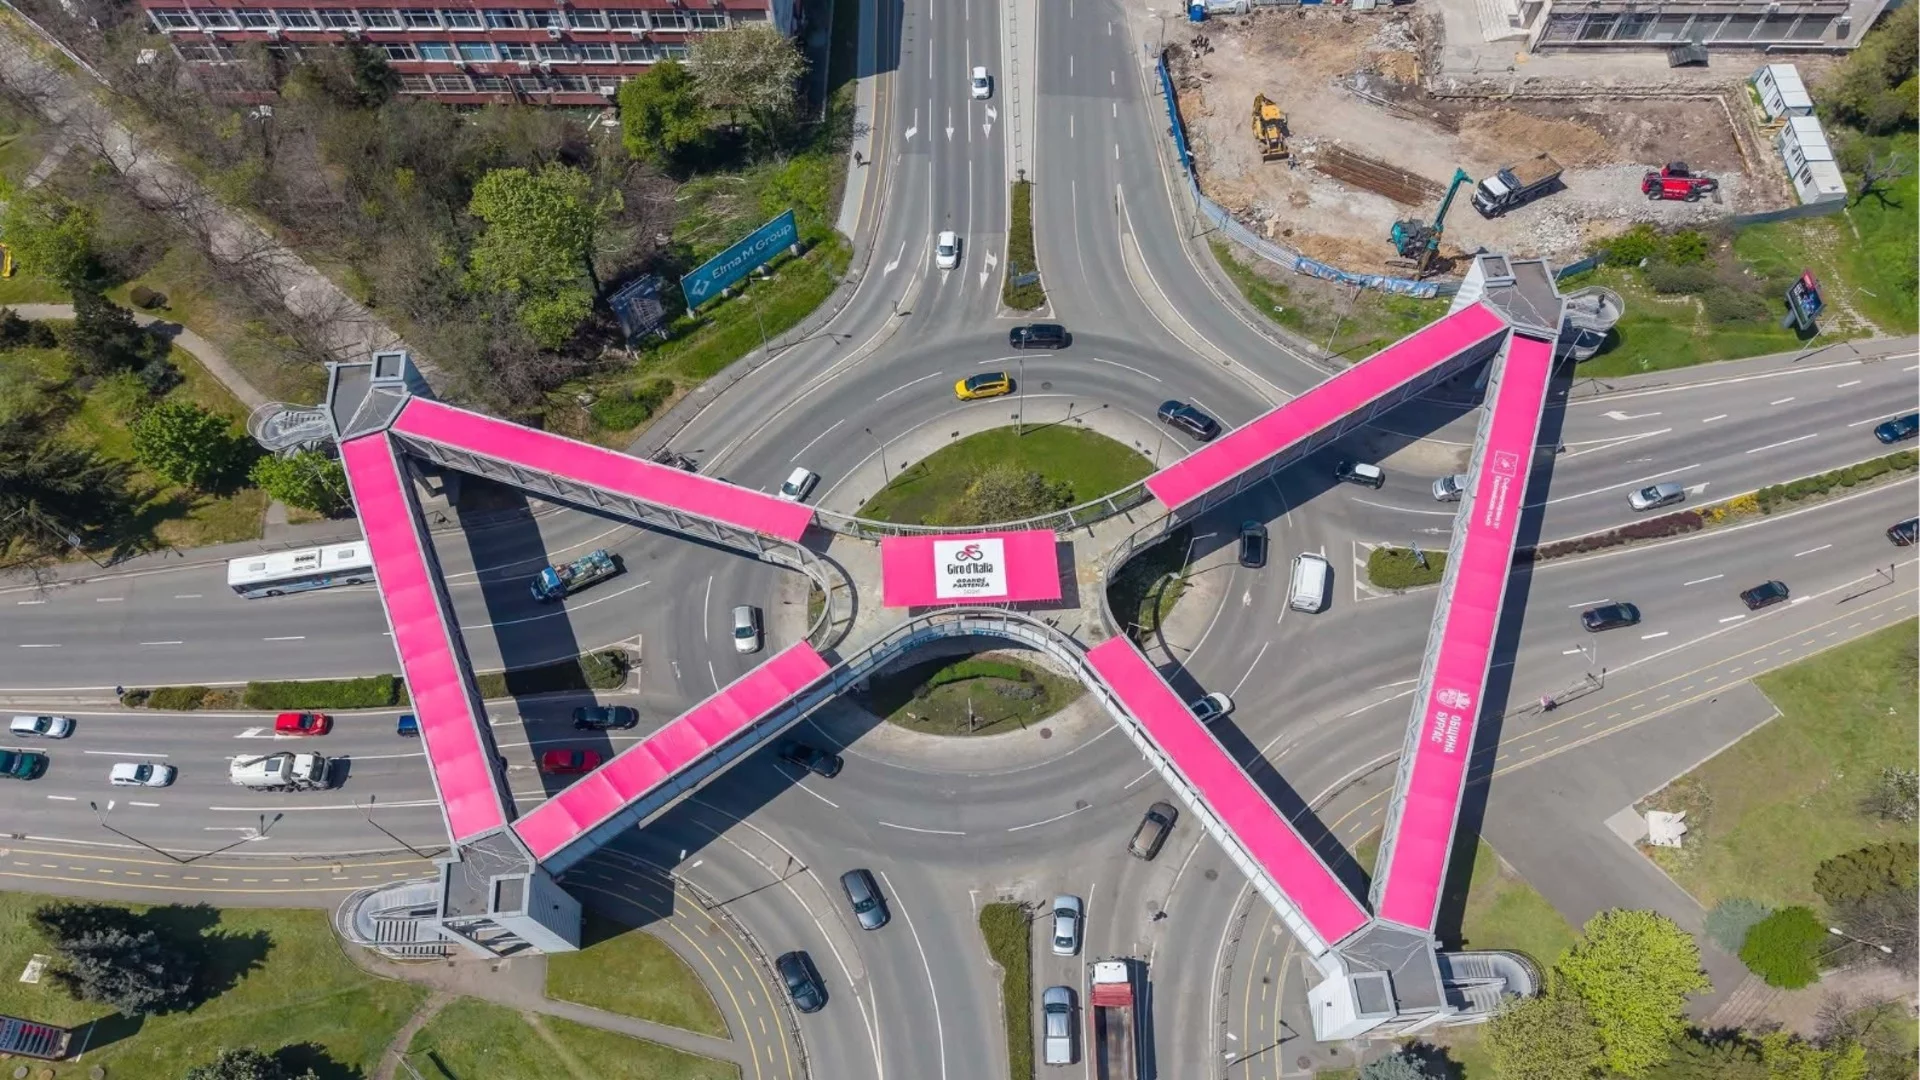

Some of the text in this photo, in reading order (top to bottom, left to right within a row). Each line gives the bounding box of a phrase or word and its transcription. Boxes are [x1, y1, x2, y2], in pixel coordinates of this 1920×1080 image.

[712, 256, 742, 279] Elma
[742, 245, 755, 260] M
[755, 224, 792, 250] Group
[947, 562, 994, 575] Giro d'Italia
[1431, 711, 1449, 743] БУРГАС
[1443, 714, 1462, 753] ОБЩИНА
